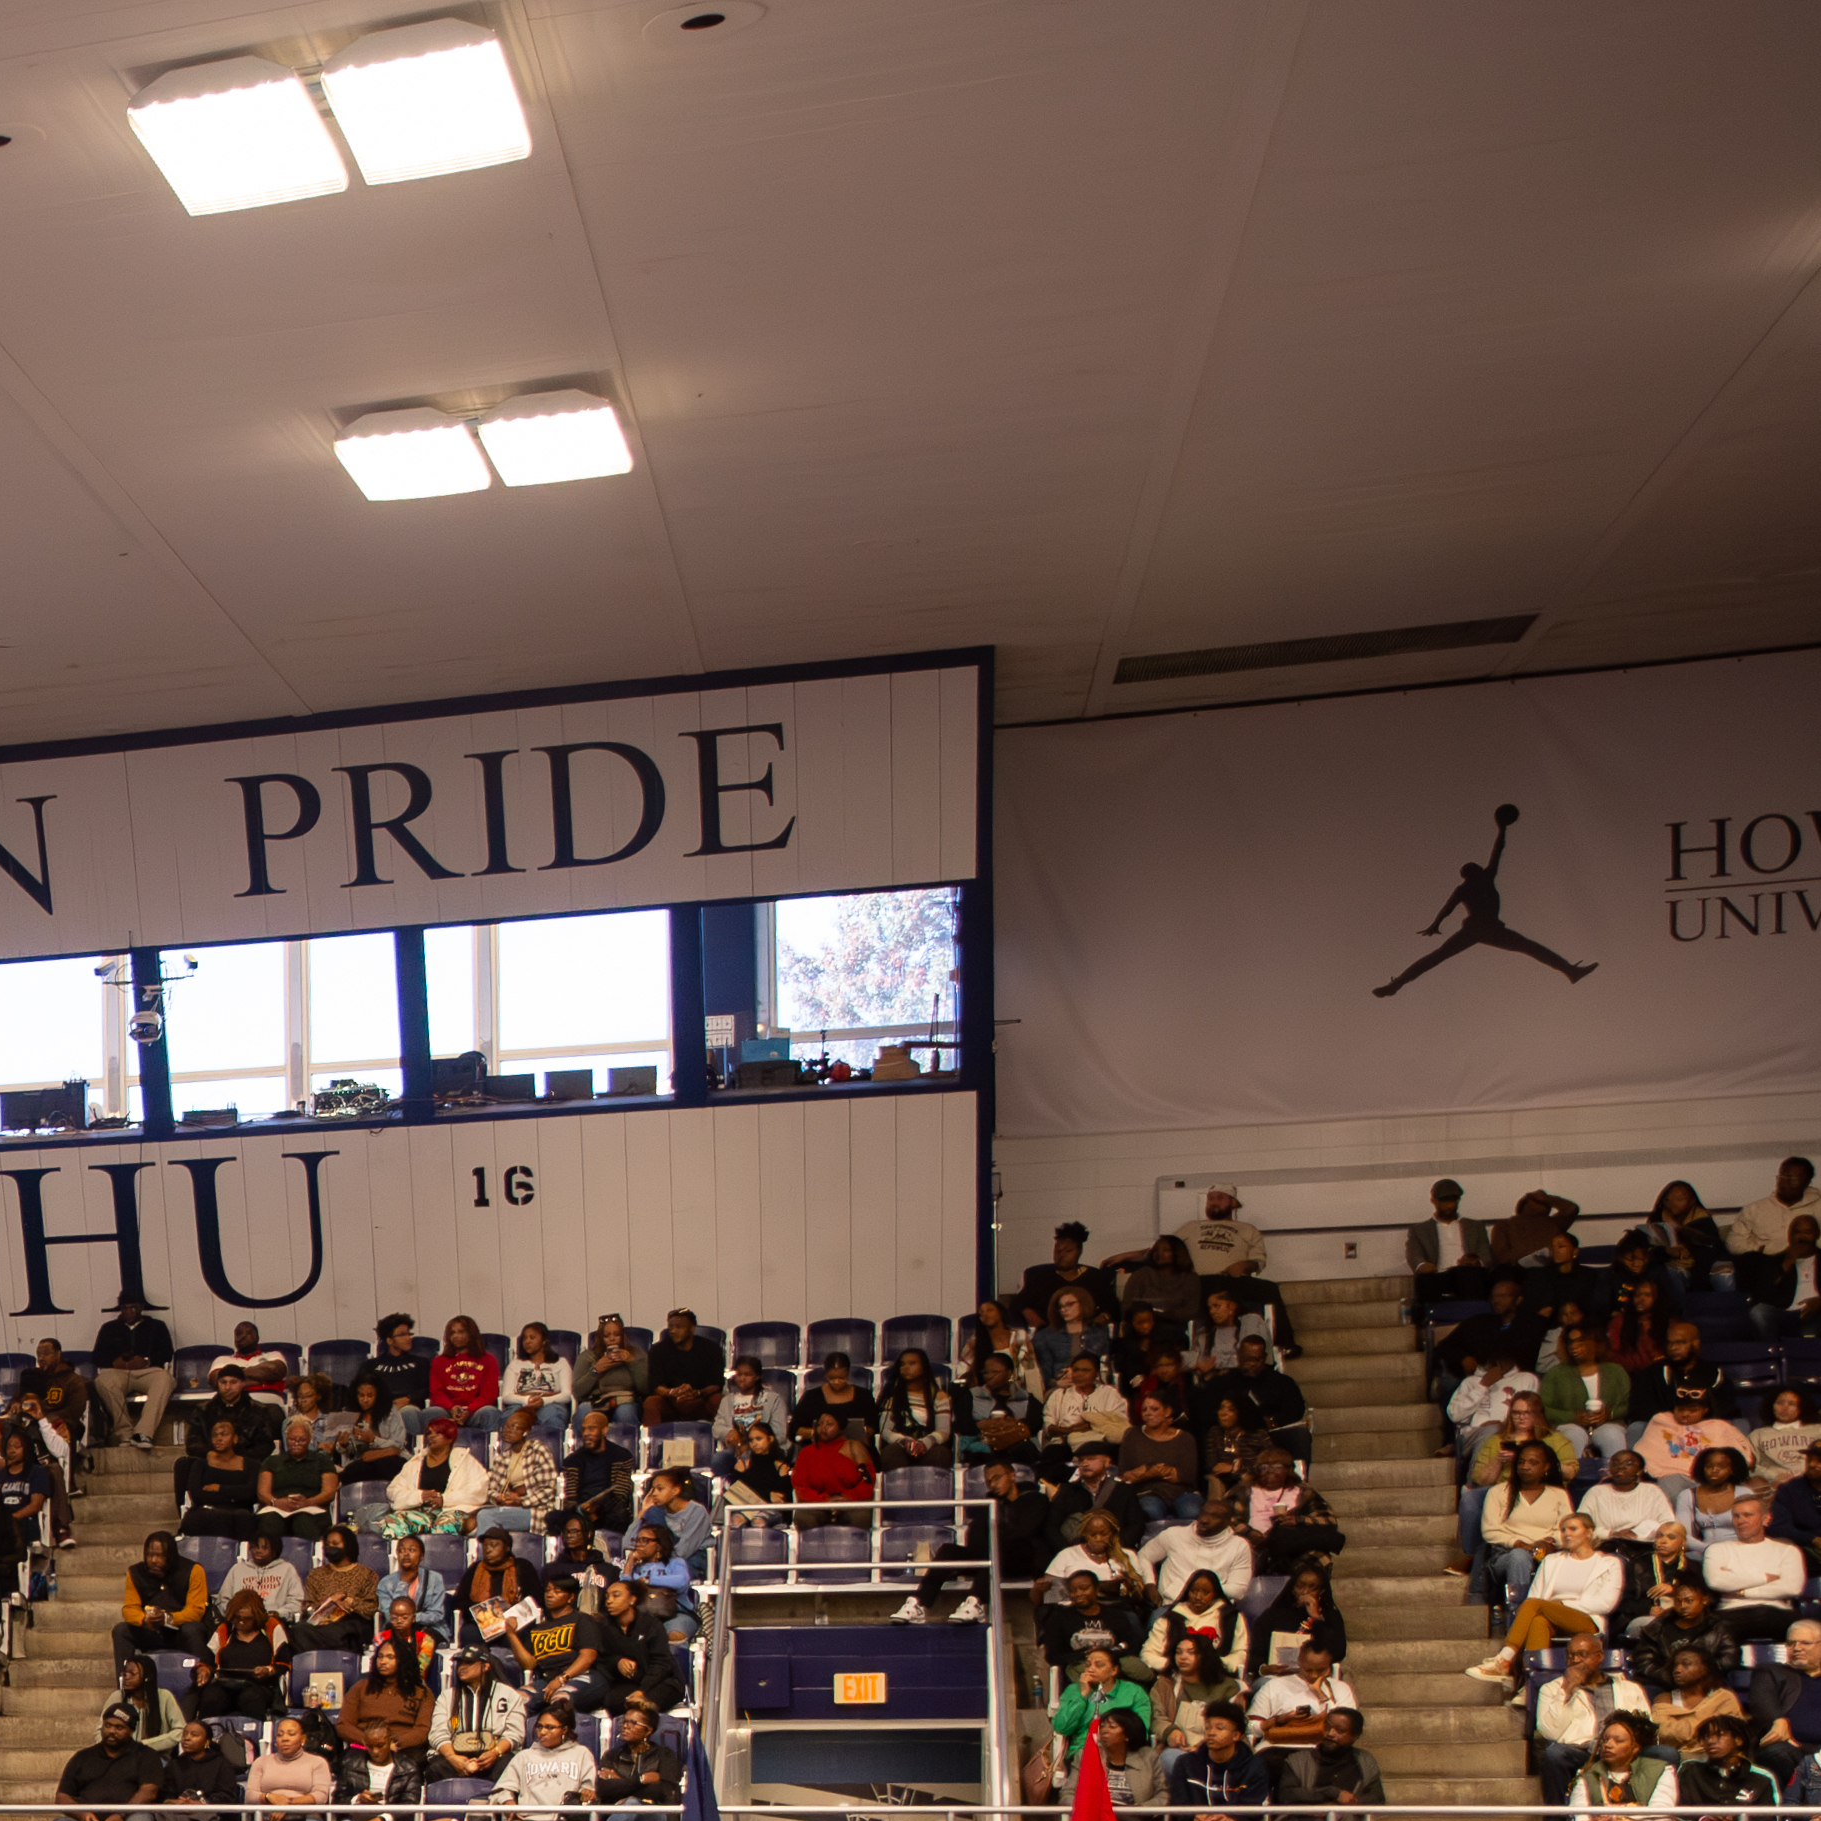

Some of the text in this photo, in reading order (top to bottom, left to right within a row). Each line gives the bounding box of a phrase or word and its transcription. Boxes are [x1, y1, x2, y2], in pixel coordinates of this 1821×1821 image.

[224, 721, 798, 899] PRIDE
[471, 1164, 536, 1208] 16
[842, 1675, 879, 1702] EXIT
[496, 1697, 508, 1714] G
[524, 1760, 579, 1783] HOWARD
